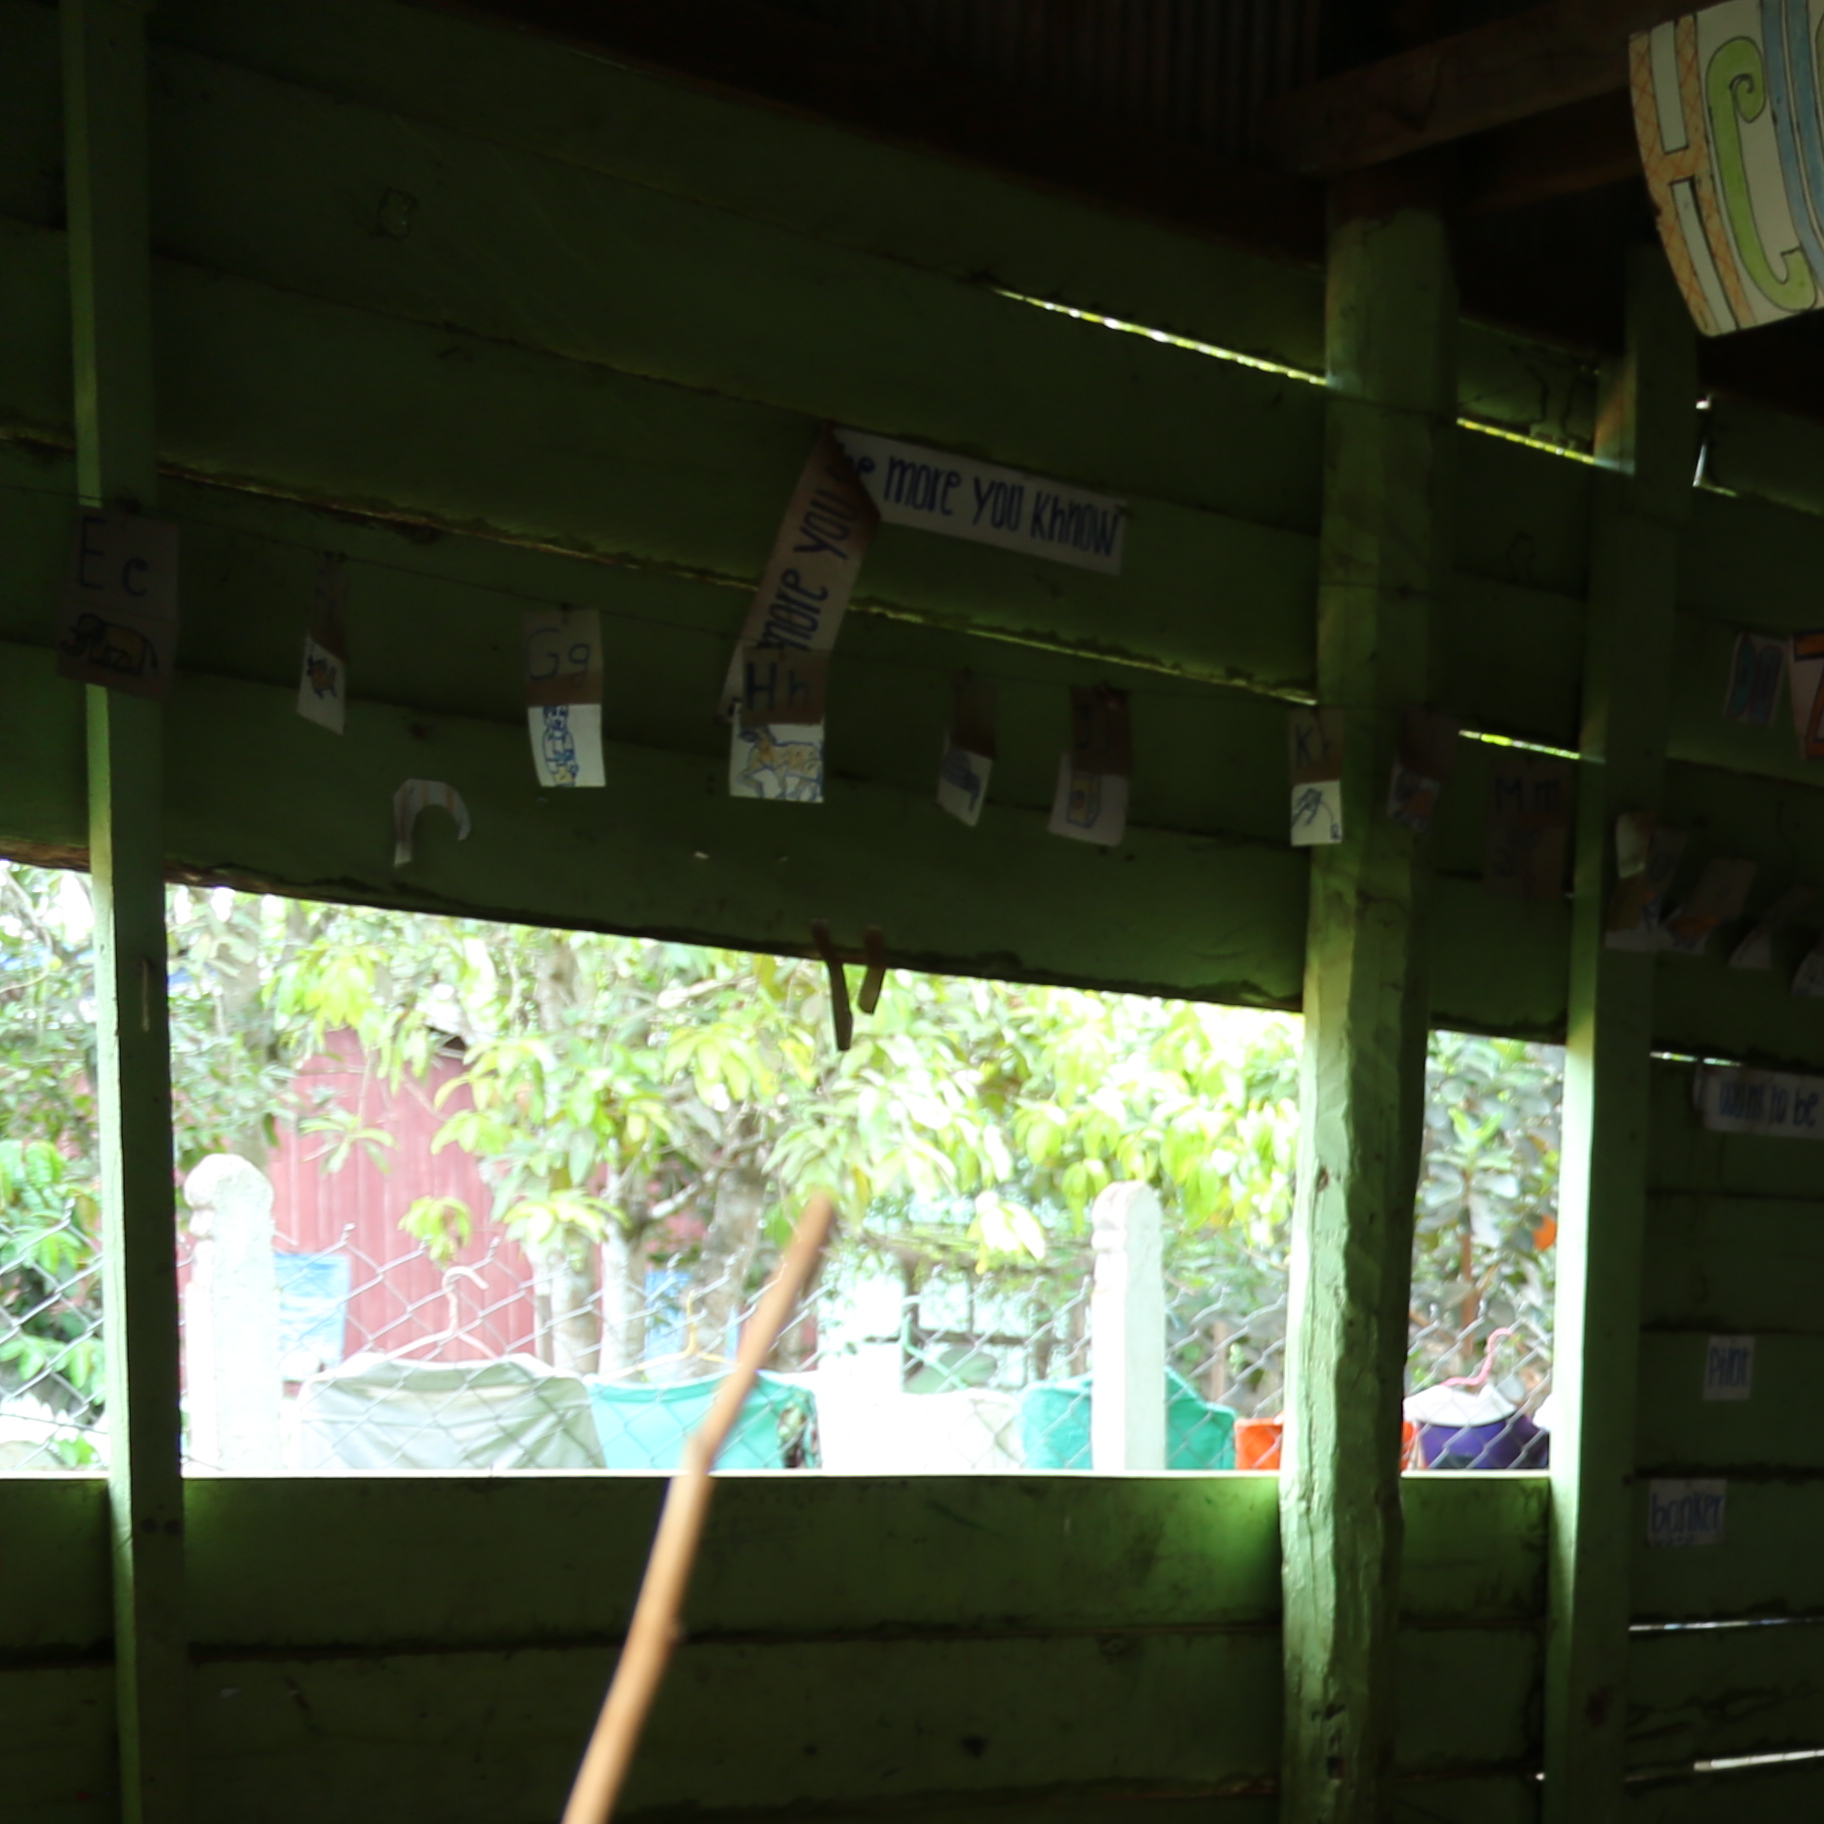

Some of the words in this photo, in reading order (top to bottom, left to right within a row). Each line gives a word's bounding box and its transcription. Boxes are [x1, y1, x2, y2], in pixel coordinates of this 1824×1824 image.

[884, 455, 961, 516] more
[973, 476, 1024, 532] you
[1793, 1091, 1819, 1127] be
[1650, 1493, 1721, 1531] banker
